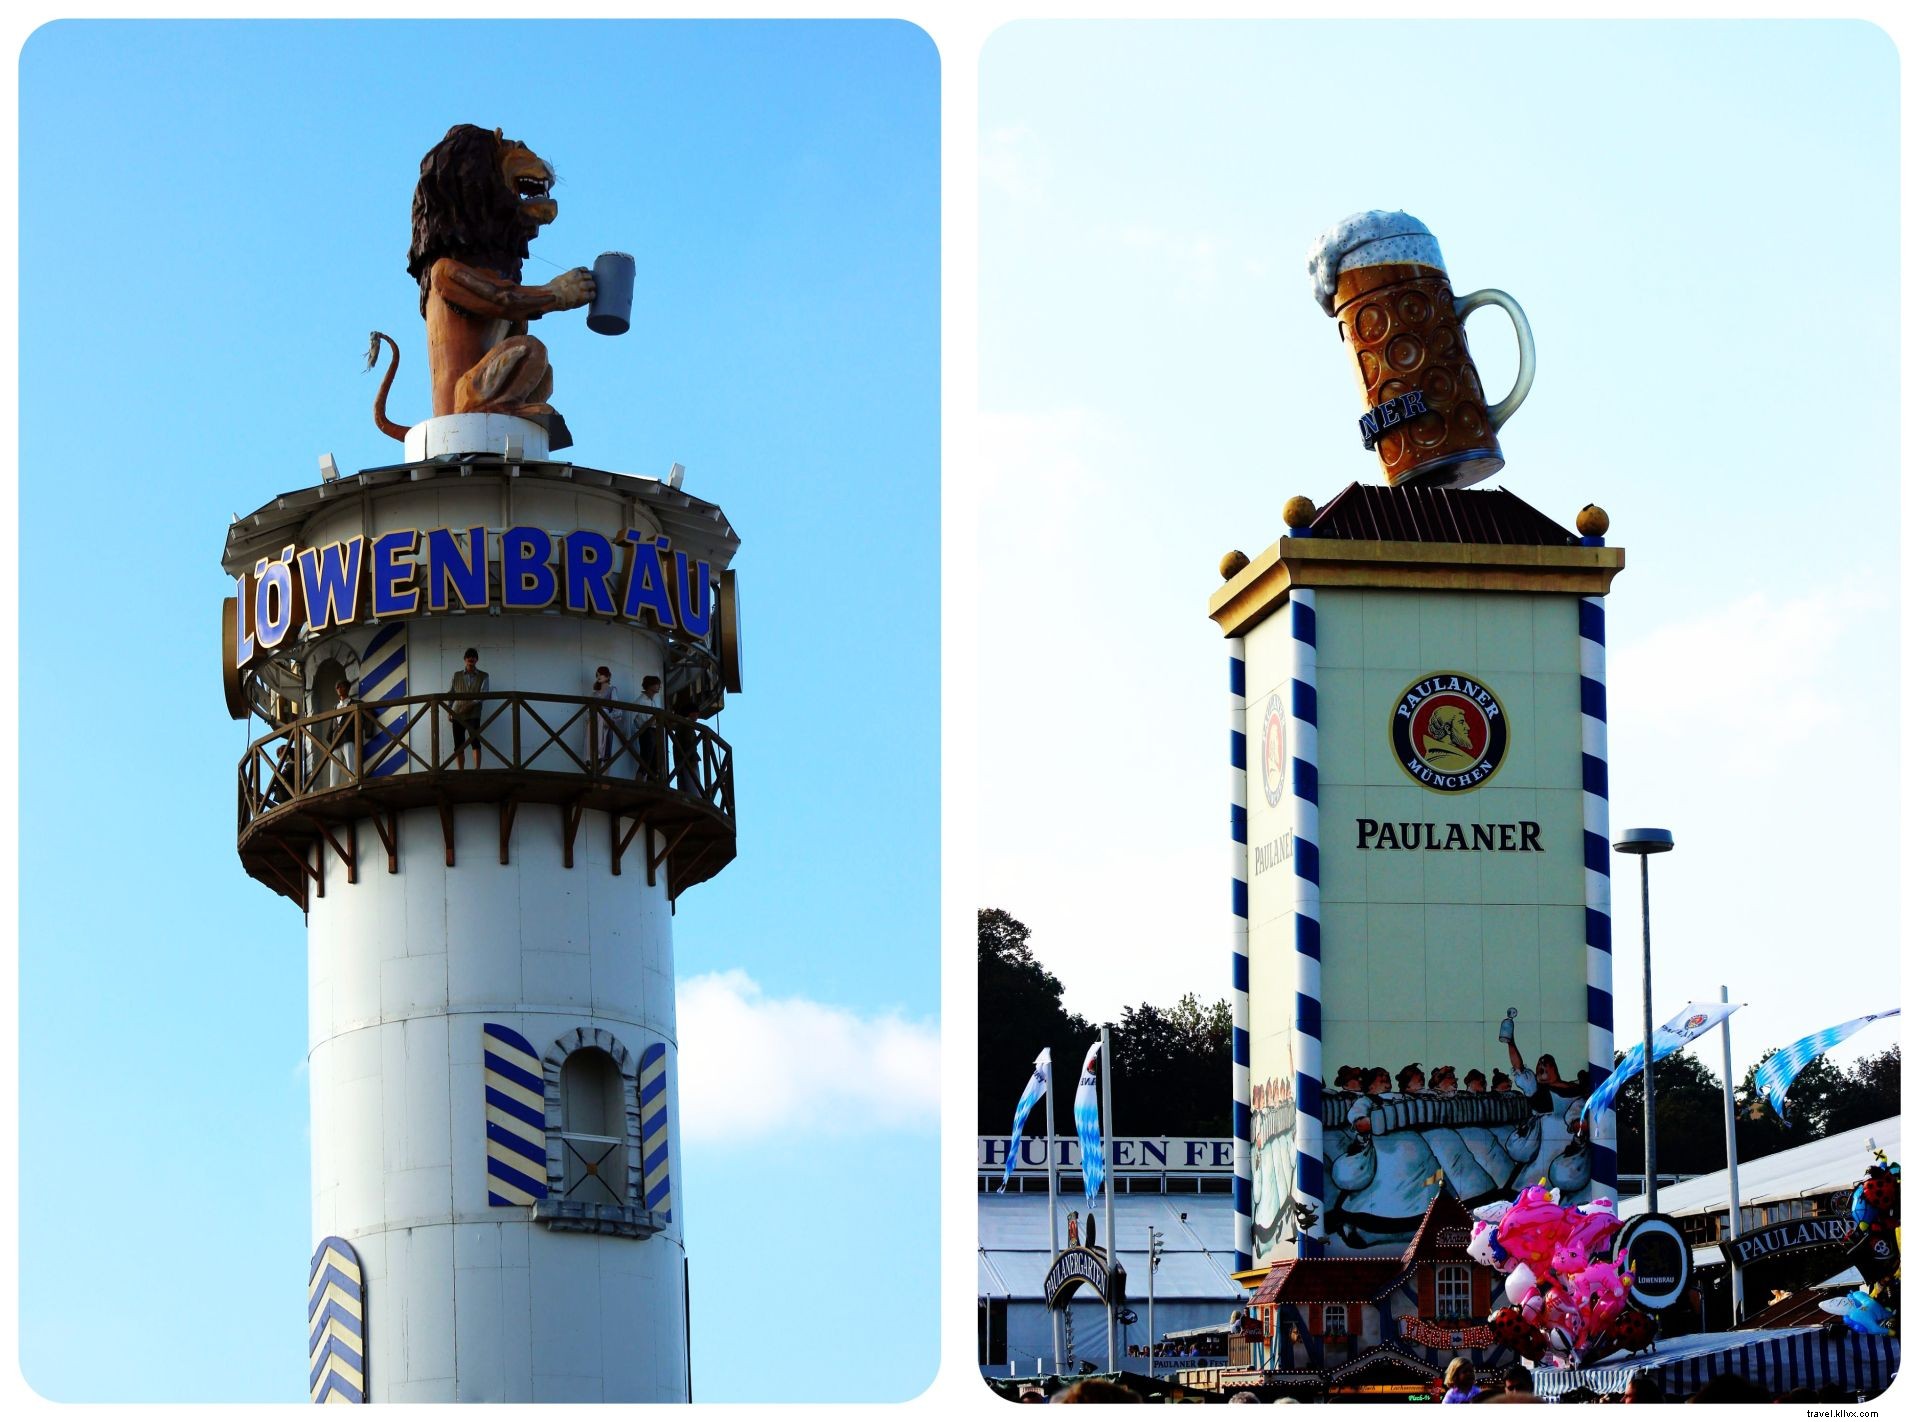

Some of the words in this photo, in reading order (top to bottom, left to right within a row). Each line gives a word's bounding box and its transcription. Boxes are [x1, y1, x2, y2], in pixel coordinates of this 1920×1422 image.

[236, 525, 712, 669] LÖWENBRÄU
[1397, 677, 1501, 719] PAULANER
[1407, 759, 1493, 788] MÜNCHEN
[1356, 818, 1545, 852] PAULANER
[978, 1135, 1169, 1167] HÜTEN
[1046, 1252, 1107, 1303] PAULANERGARTEN
[1154, 1359, 1196, 1369] PAULANER
